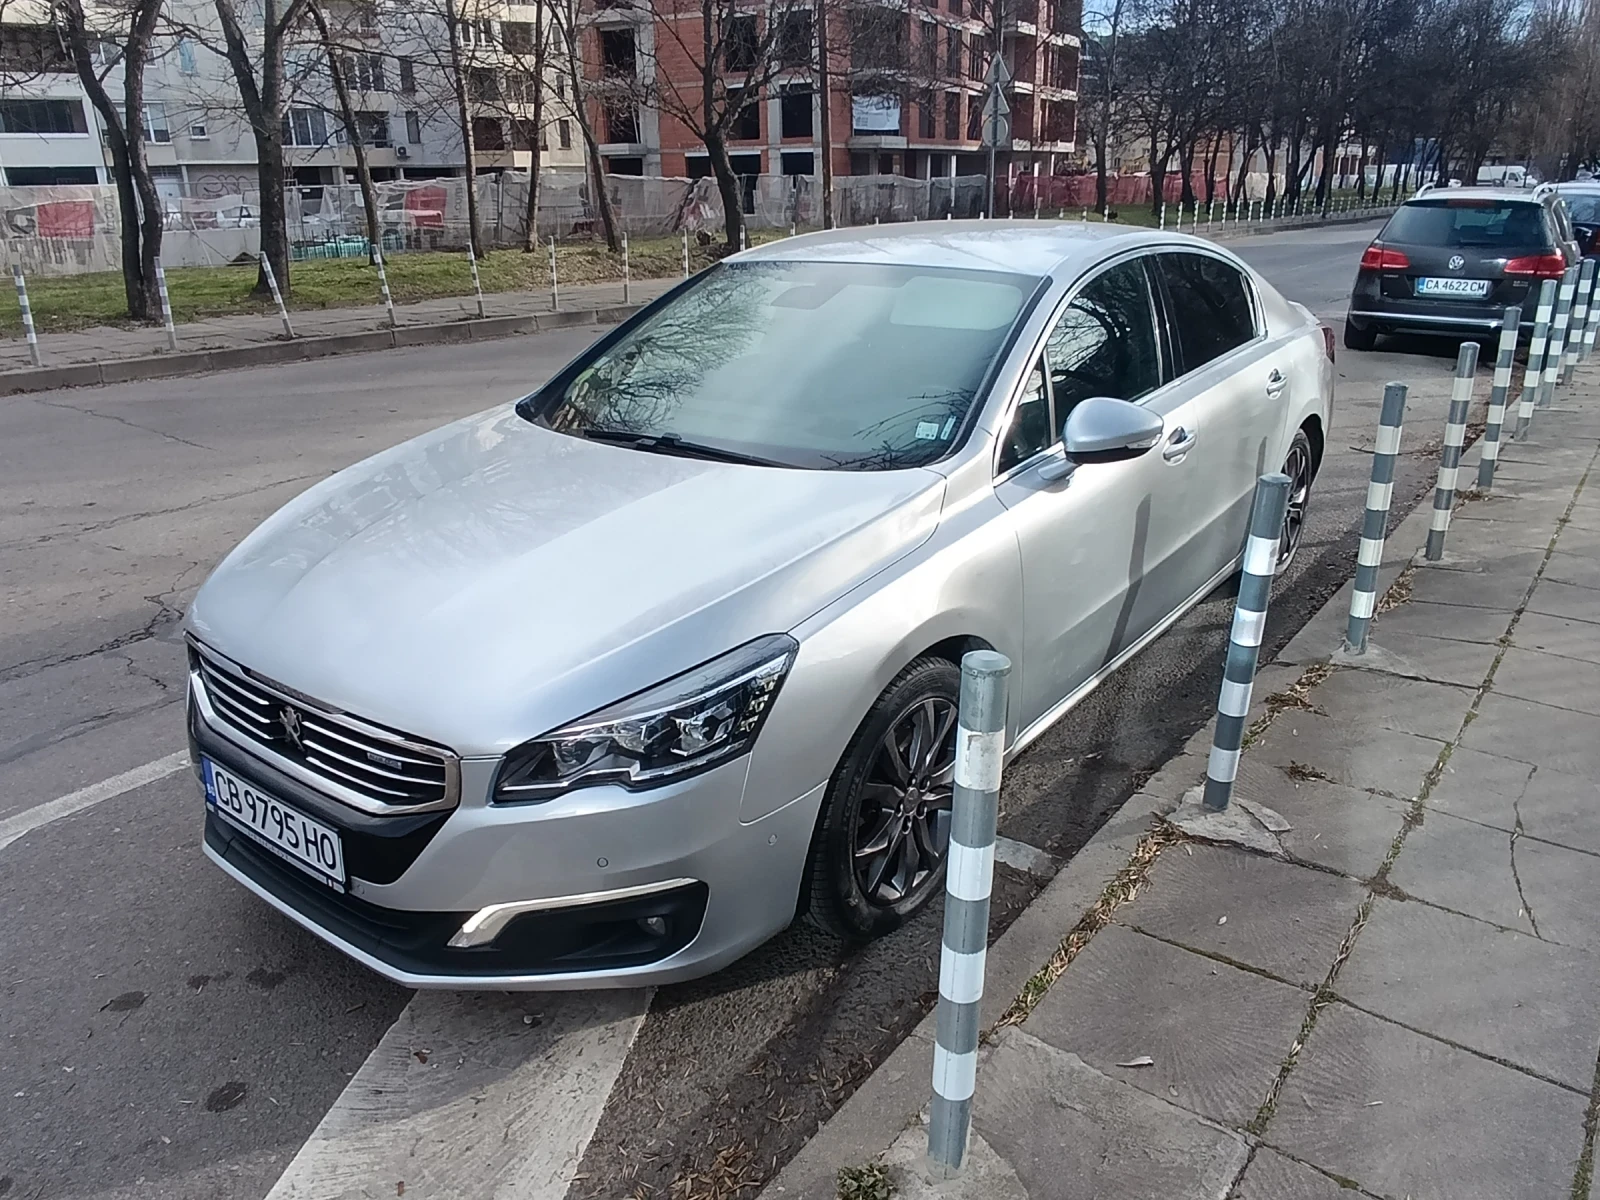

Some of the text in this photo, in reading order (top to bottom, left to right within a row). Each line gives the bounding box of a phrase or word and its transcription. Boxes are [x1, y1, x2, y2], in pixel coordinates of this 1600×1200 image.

[1425, 279, 1439, 290] CA
[1442, 280, 1469, 292] 4622
[1470, 281, 1486, 292] CM
[215, 770, 243, 814] CB
[243, 789, 300, 849] 9795
